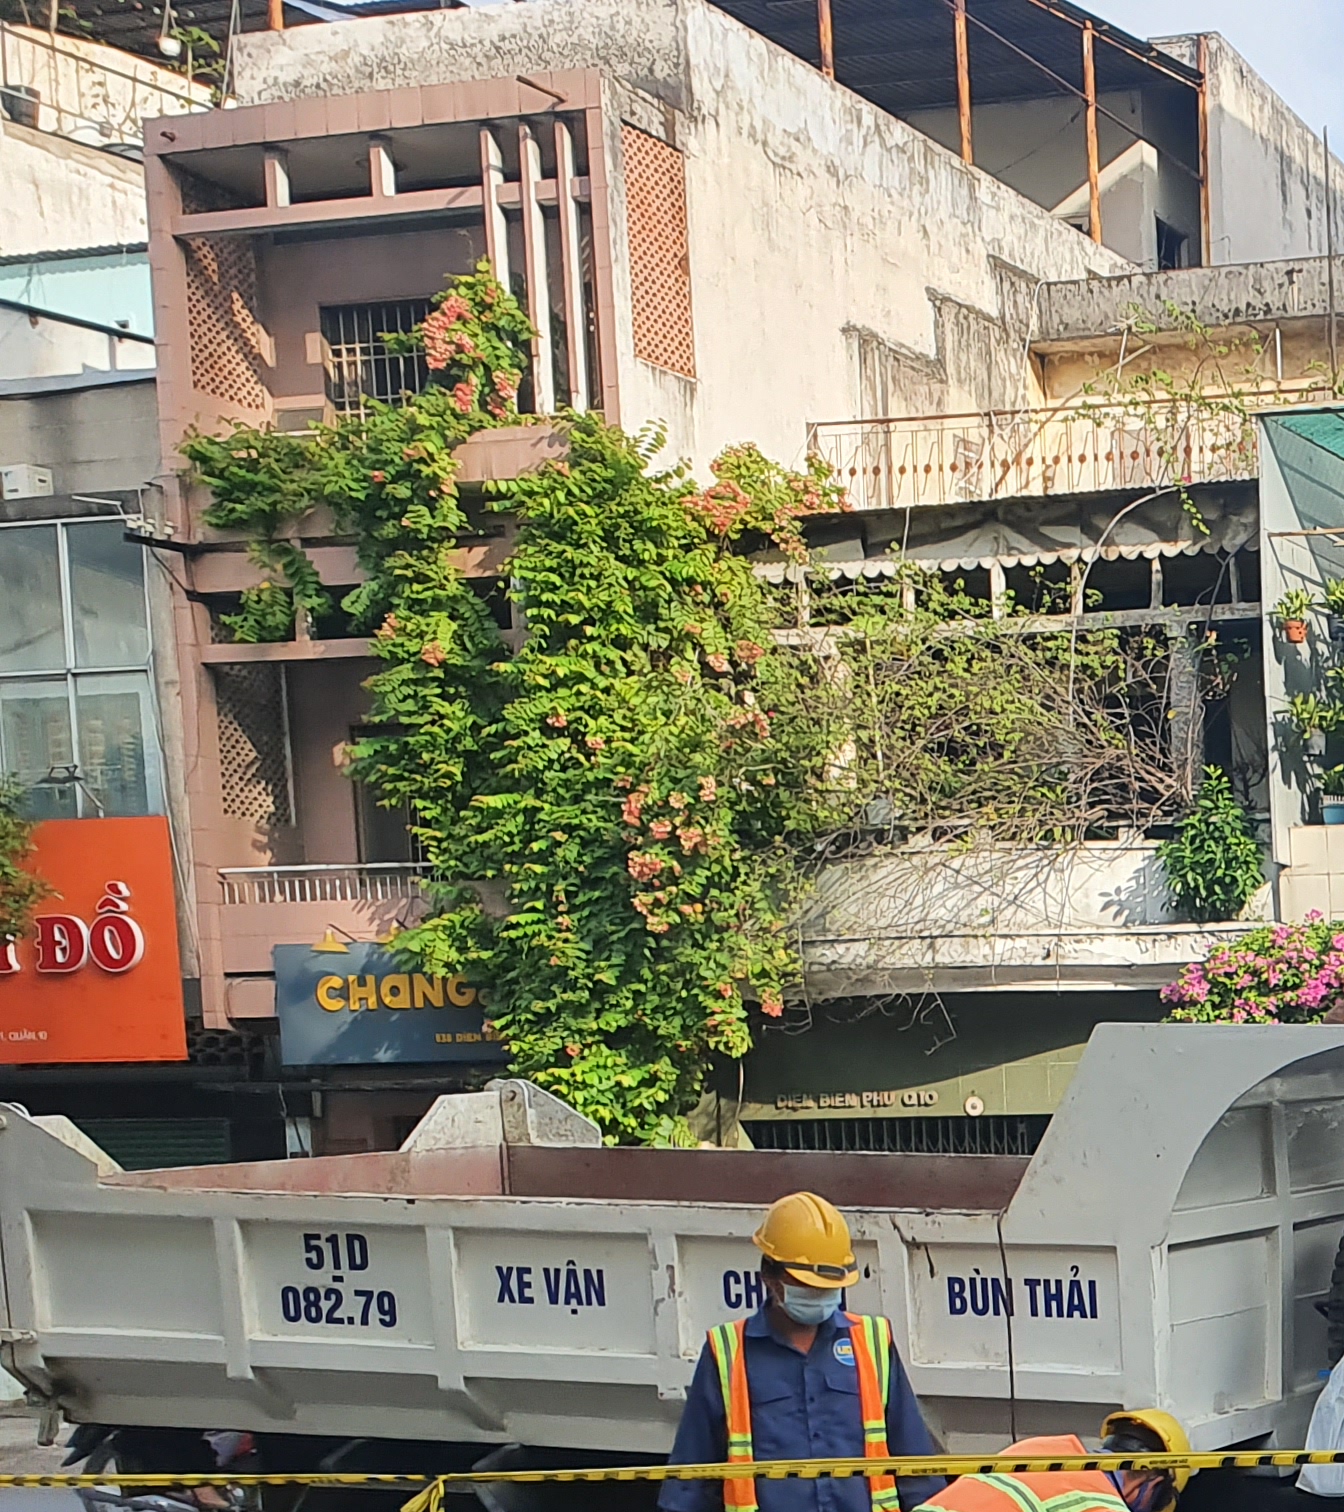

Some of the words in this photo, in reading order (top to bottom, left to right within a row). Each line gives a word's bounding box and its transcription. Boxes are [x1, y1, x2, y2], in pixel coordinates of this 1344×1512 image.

[34, 881, 145, 973] ĐỒ
[303, 1233, 369, 1271] 51D
[281, 1286, 397, 1328] 082.79
[495, 1265, 535, 1305] XE
[543, 1259, 606, 1315] VẬN
[947, 1268, 1014, 1317] BÙN
[1024, 1265, 1098, 1319] THẢI
